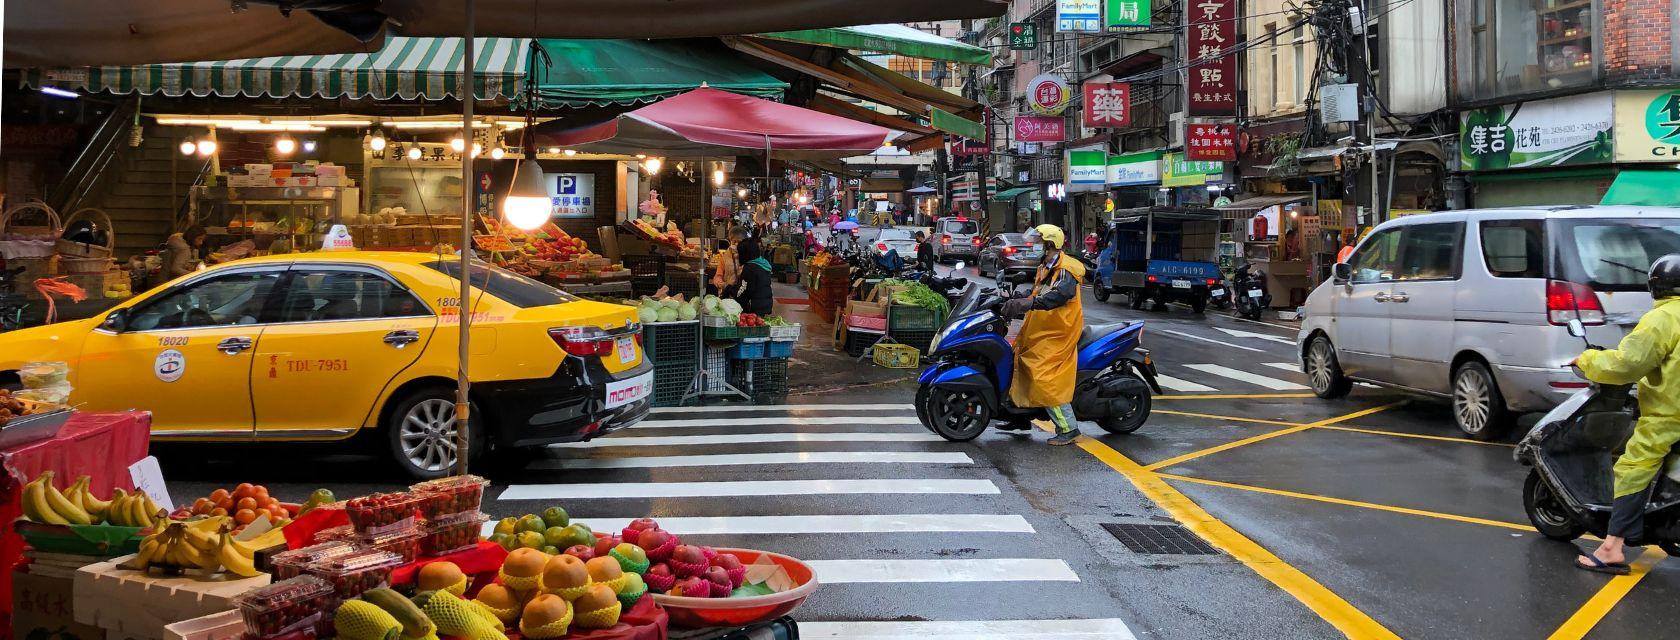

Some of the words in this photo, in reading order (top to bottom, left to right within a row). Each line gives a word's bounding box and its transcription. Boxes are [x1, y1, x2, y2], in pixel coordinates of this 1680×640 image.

[1061, 2, 1097, 10] FamilyMart
[1092, 88, 1124, 122] 藥
[1470, 124, 1508, 155] 集吉
[1515, 126, 1541, 149] 花苑
[1070, 169, 1105, 177] FamilyMart
[436, 297, 461, 307] 1802
[158, 336, 189, 346] 18020
[286, 359, 349, 372] TDU-7951
